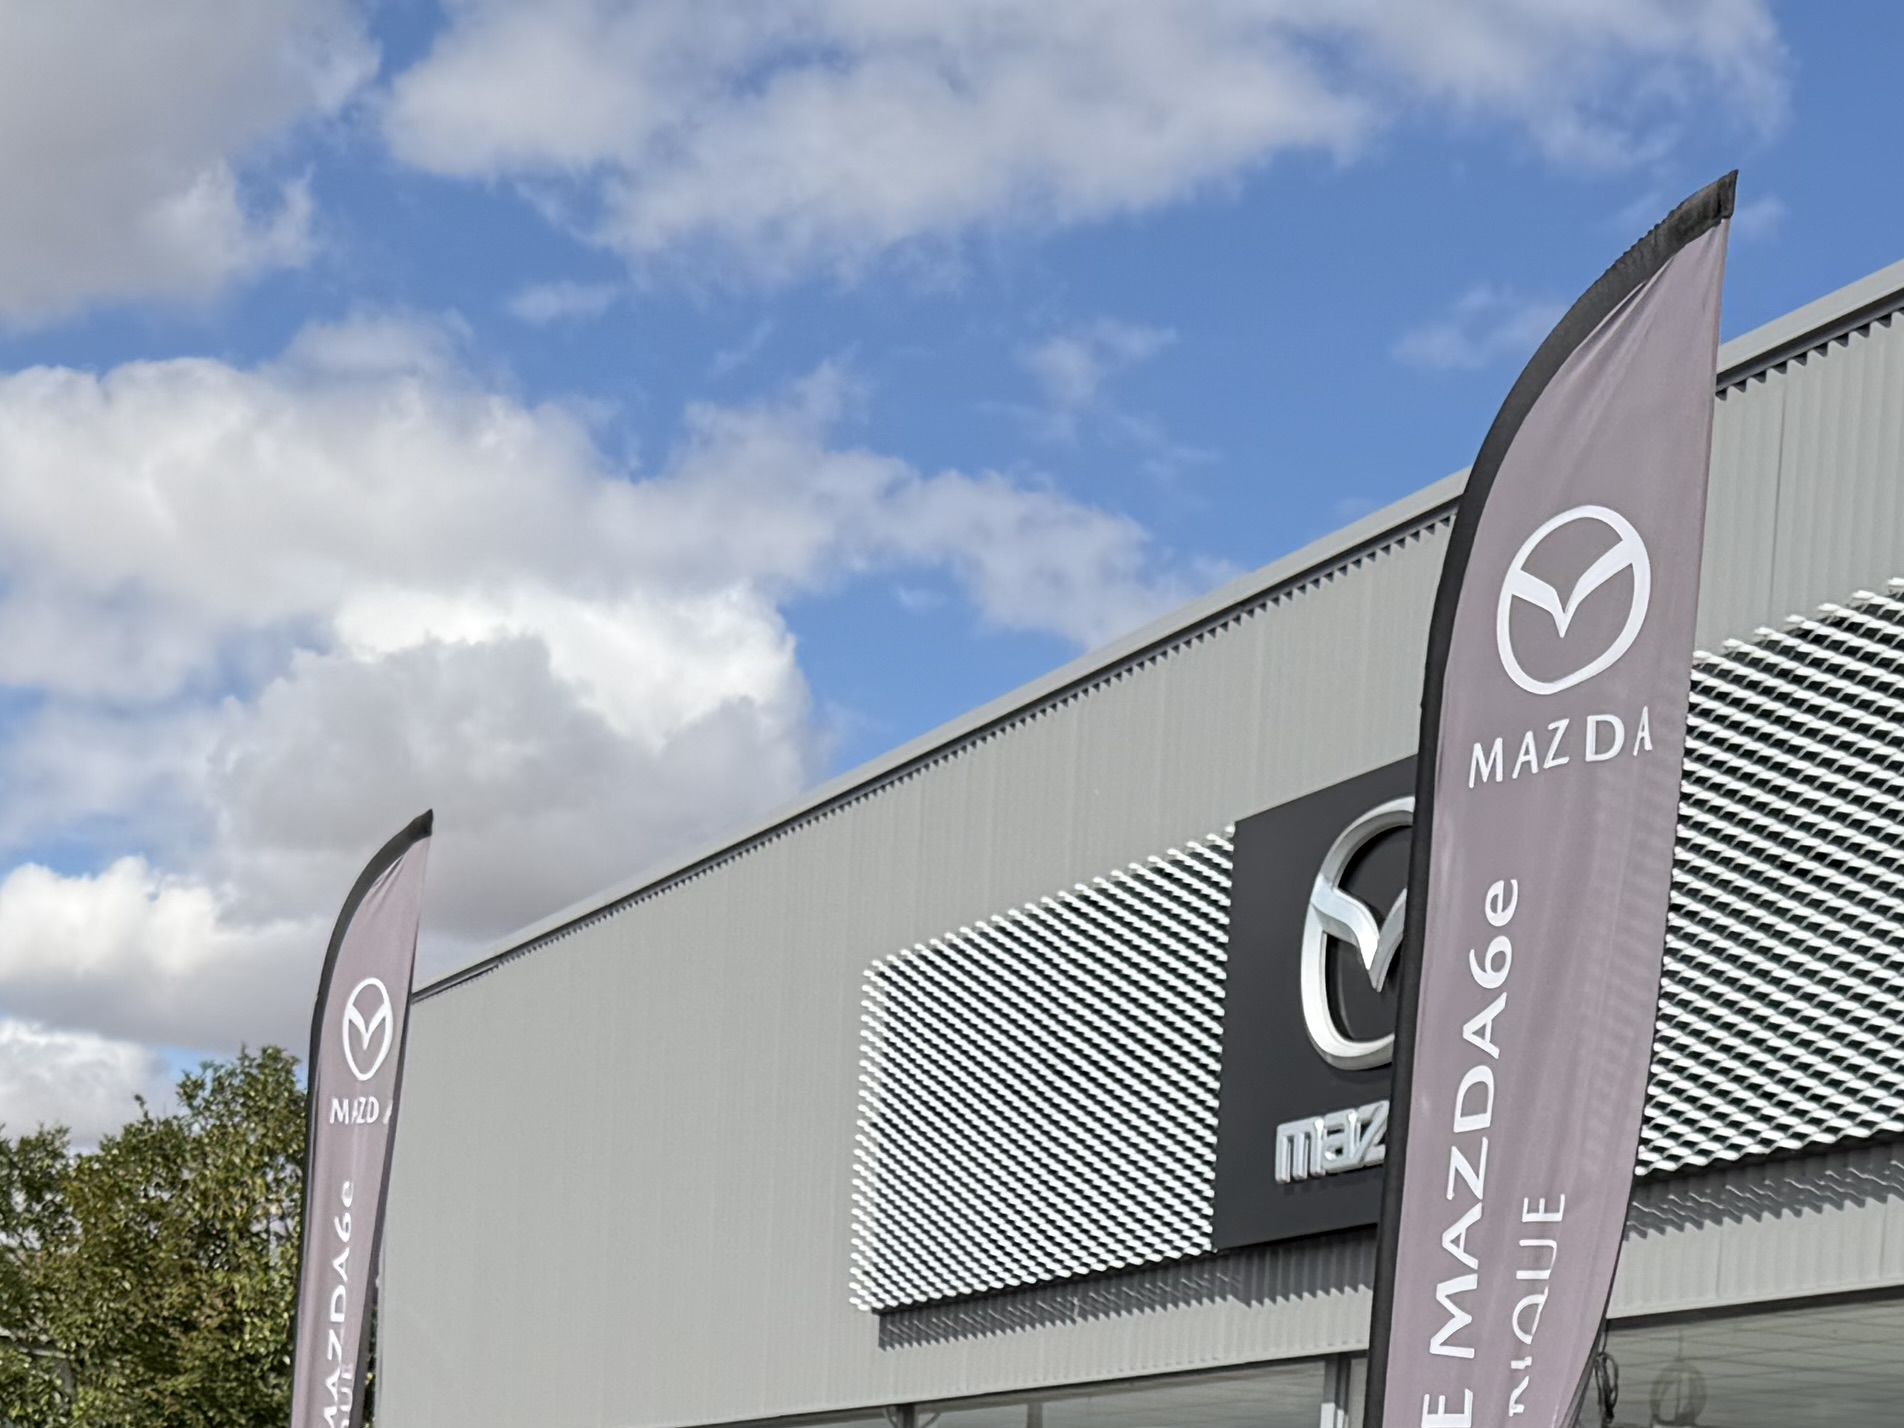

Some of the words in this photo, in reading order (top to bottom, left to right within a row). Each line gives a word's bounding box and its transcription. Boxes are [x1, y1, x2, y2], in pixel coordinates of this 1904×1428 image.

[1468, 705, 1654, 788] MAZDA
[1274, 1100, 1390, 1185] maz
[1428, 879, 1520, 1359] MAZDA6e
